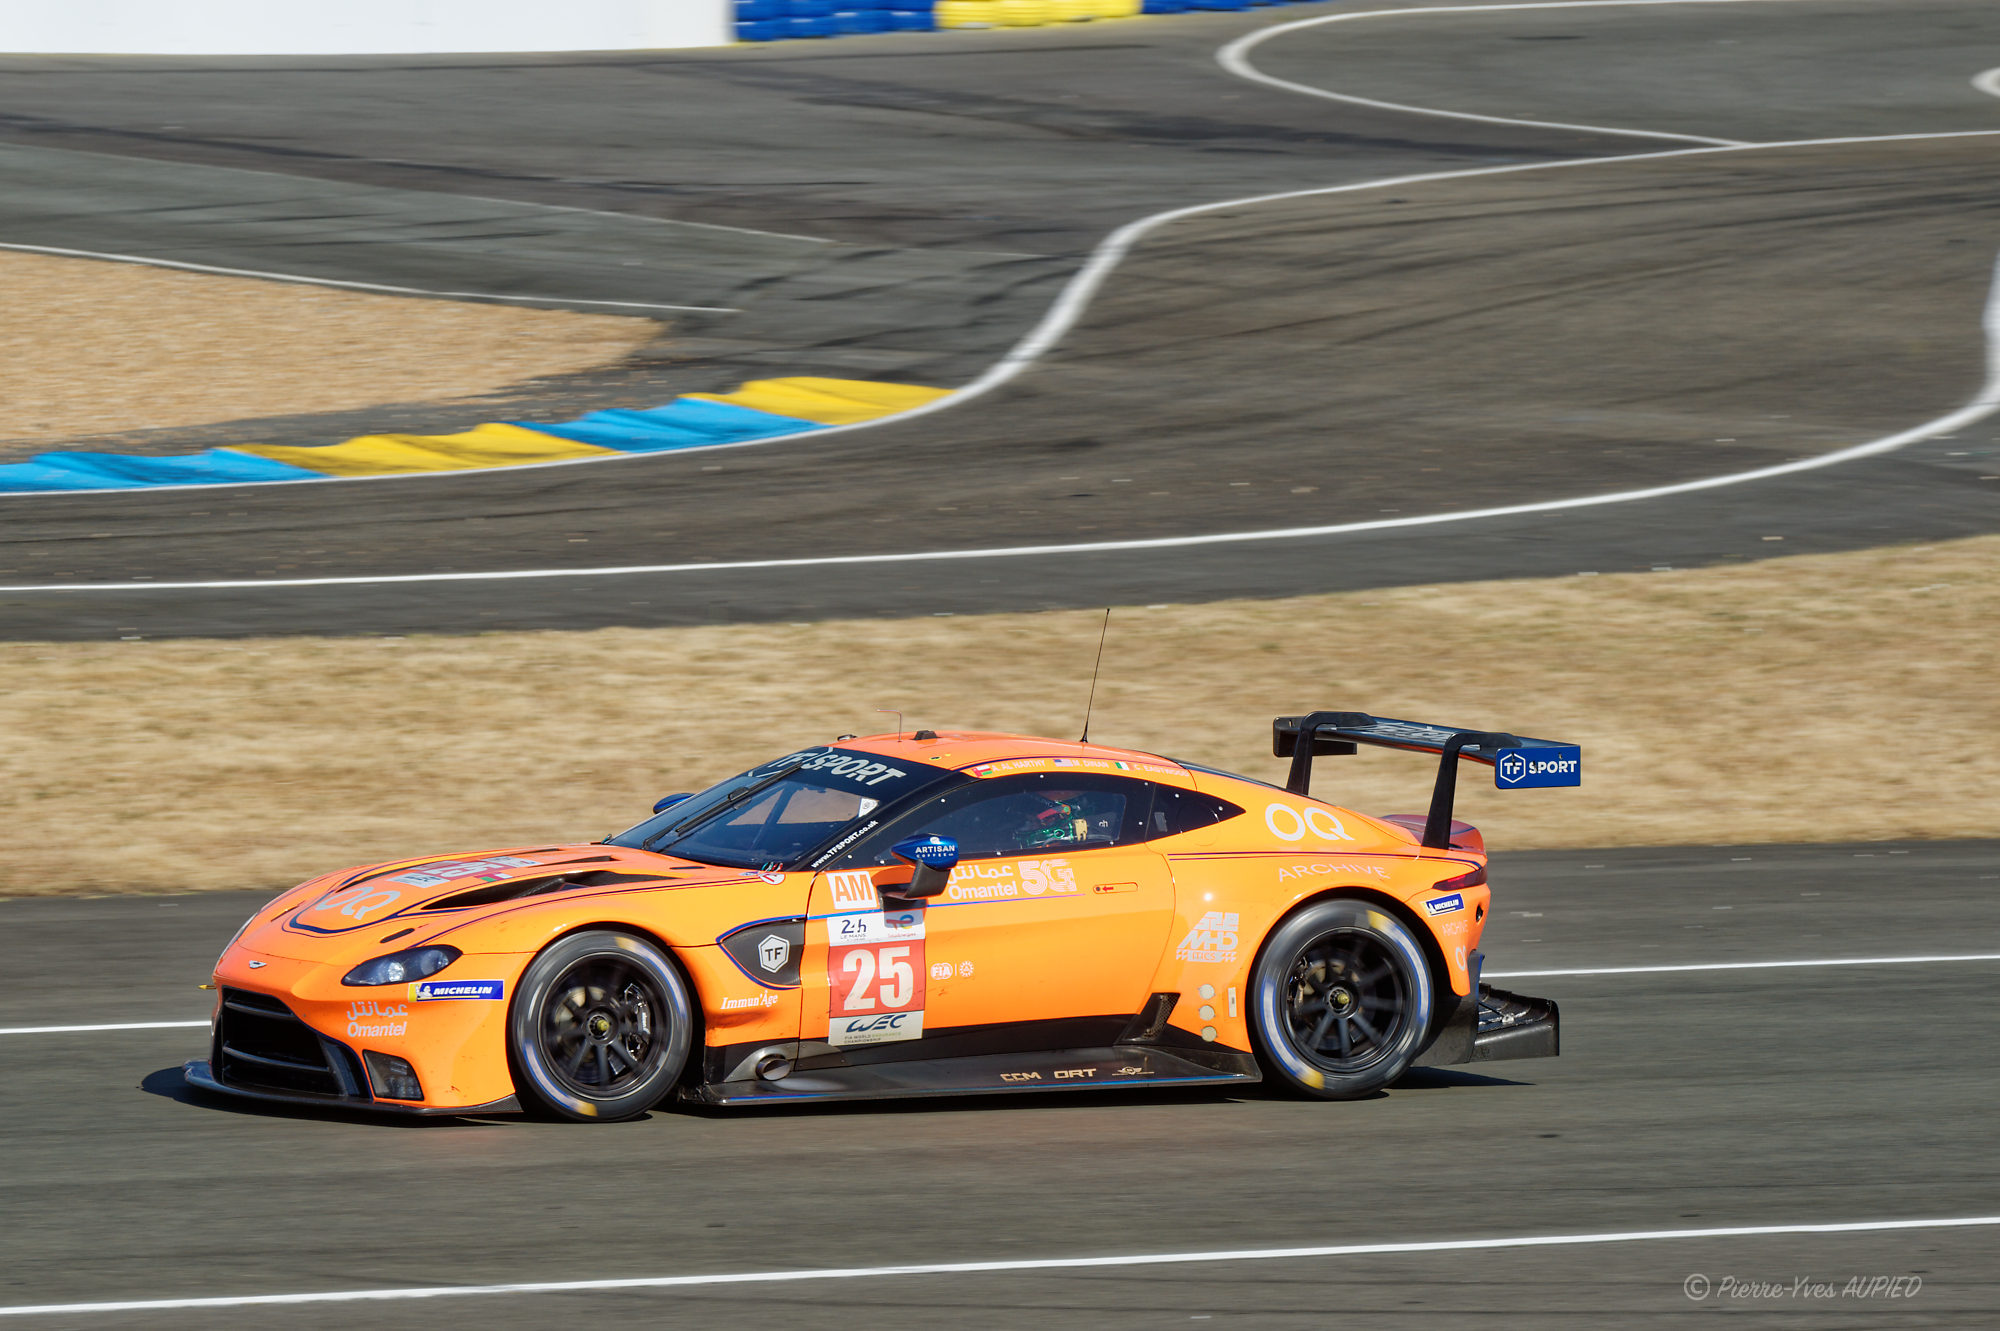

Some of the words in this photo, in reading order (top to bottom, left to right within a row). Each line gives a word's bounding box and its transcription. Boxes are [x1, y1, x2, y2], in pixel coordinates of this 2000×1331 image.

[768, 752, 818, 767] TF
[801, 754, 907, 786] SPORT
[1504, 762, 1522, 774] TF
[1528, 760, 1577, 774] SPORT
[1265, 803, 1354, 840] OQ
[811, 820, 878, 868] www.TFSPORT.co.uk
[915, 844, 956, 854] ARTISAN
[948, 880, 1018, 900] Omantel
[1018, 859, 1078, 895] 5G
[1279, 864, 1391, 882] ARCHIVE
[836, 874, 872, 902] AM
[1178, 930, 1238, 950] MHD
[765, 946, 783, 961] TF
[843, 946, 914, 1010] 25
[932, 965, 952, 978] FIA
[433, 986, 492, 995] MICHELIN
[347, 1001, 408, 1020] عمانتل
[348, 1021, 408, 1037] Omantel
[846, 1014, 908, 1032] WEC
[1000, 1072, 1042, 1082] CCM
[1054, 1068, 1096, 1079] ORT
